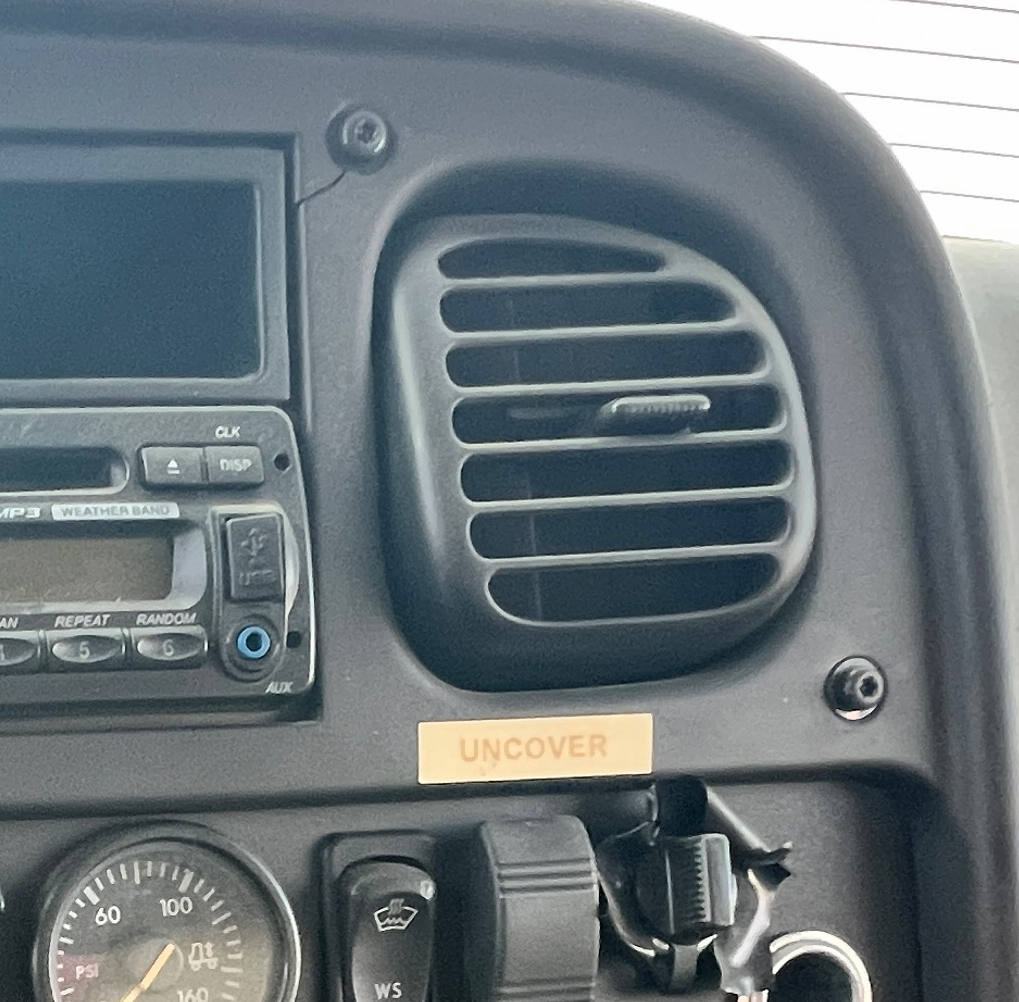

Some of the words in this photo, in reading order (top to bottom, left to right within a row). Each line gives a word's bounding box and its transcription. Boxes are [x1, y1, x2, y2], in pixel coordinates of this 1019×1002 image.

[216, 426, 241, 438] CLK
[220, 458, 252, 472] DISP
[61, 506, 129, 518] WEATHER
[132, 504, 171, 517] BAND
[54, 614, 111, 628] REPEAT
[136, 612, 197, 626] RANDOM
[79, 641, 91, 658] 5
[162, 640, 174, 657] 6
[265, 682, 293, 694] AUX
[460, 734, 608, 763] UNCOVER
[94, 905, 122, 926] 60
[159, 896, 193, 918] 100
[75, 963, 99, 980] PSI
[374, 982, 403, 999] WS
